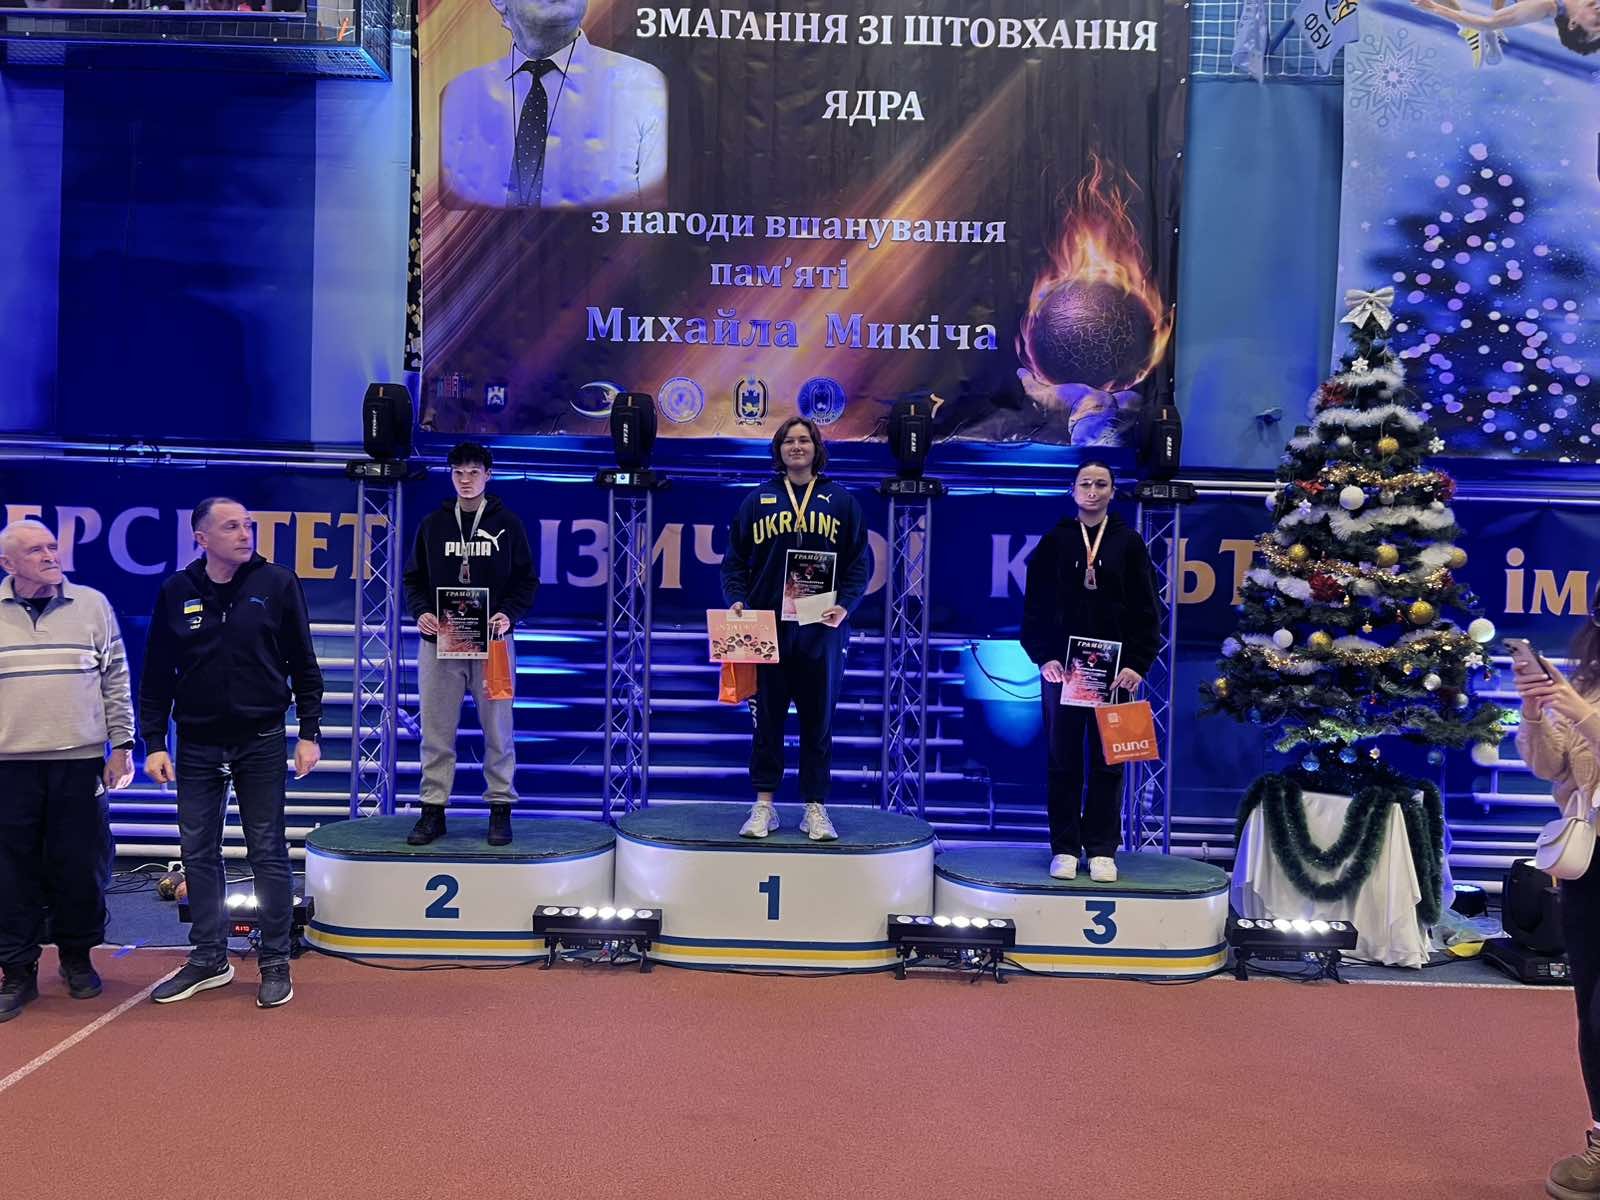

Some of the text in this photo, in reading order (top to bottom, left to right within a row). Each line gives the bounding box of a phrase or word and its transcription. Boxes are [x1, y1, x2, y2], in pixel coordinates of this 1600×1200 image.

[636, 7, 1158, 53] ЗМАГАННЯ ЗІ ШТОВХАННЯ
[822, 90, 925, 128] ЯДРА
[591, 211, 1007, 249] з нагоди вшанування
[585, 305, 998, 351] Михайла Микіча
[752, 510, 841, 545] UKRAINE
[424, 874, 460, 919] 2
[758, 875, 781, 921] 1
[1082, 900, 1118, 945] 3
